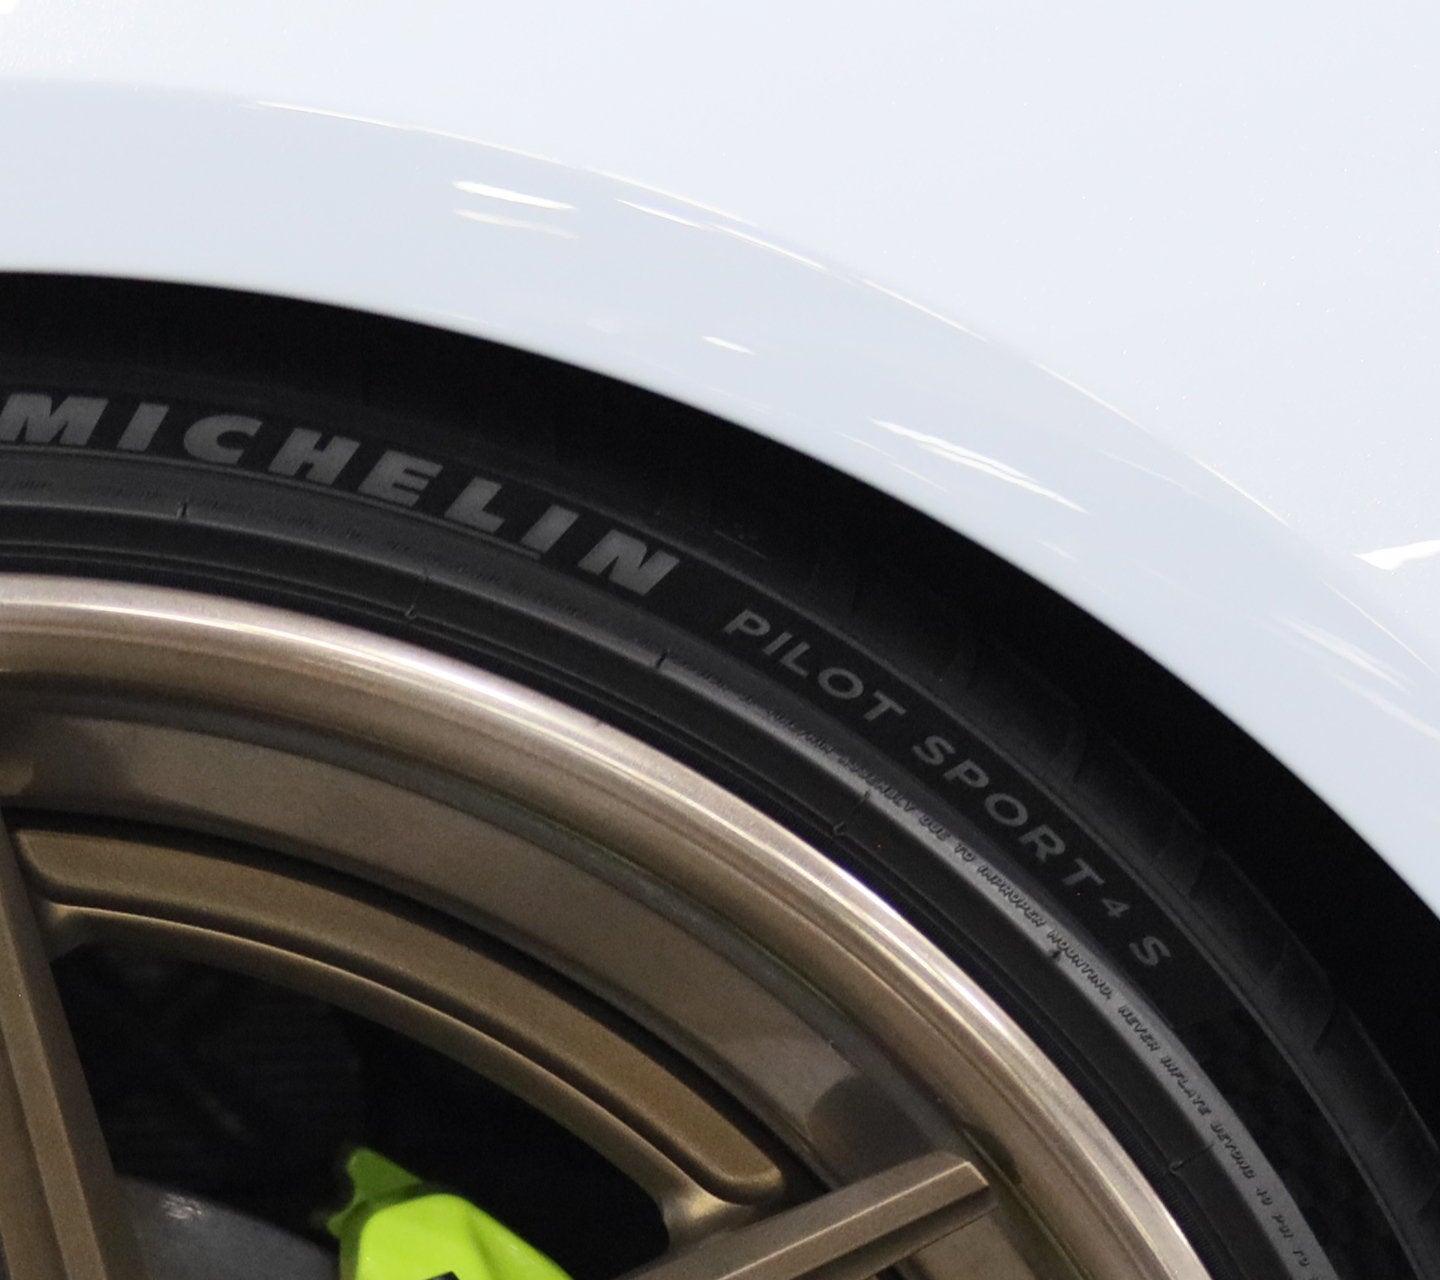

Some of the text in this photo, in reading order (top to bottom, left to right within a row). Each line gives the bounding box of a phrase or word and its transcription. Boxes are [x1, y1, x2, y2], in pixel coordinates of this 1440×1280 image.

[721, 602, 907, 735] PILOT
[909, 727, 1105, 903] SPORT
[1125, 927, 1172, 975] S
